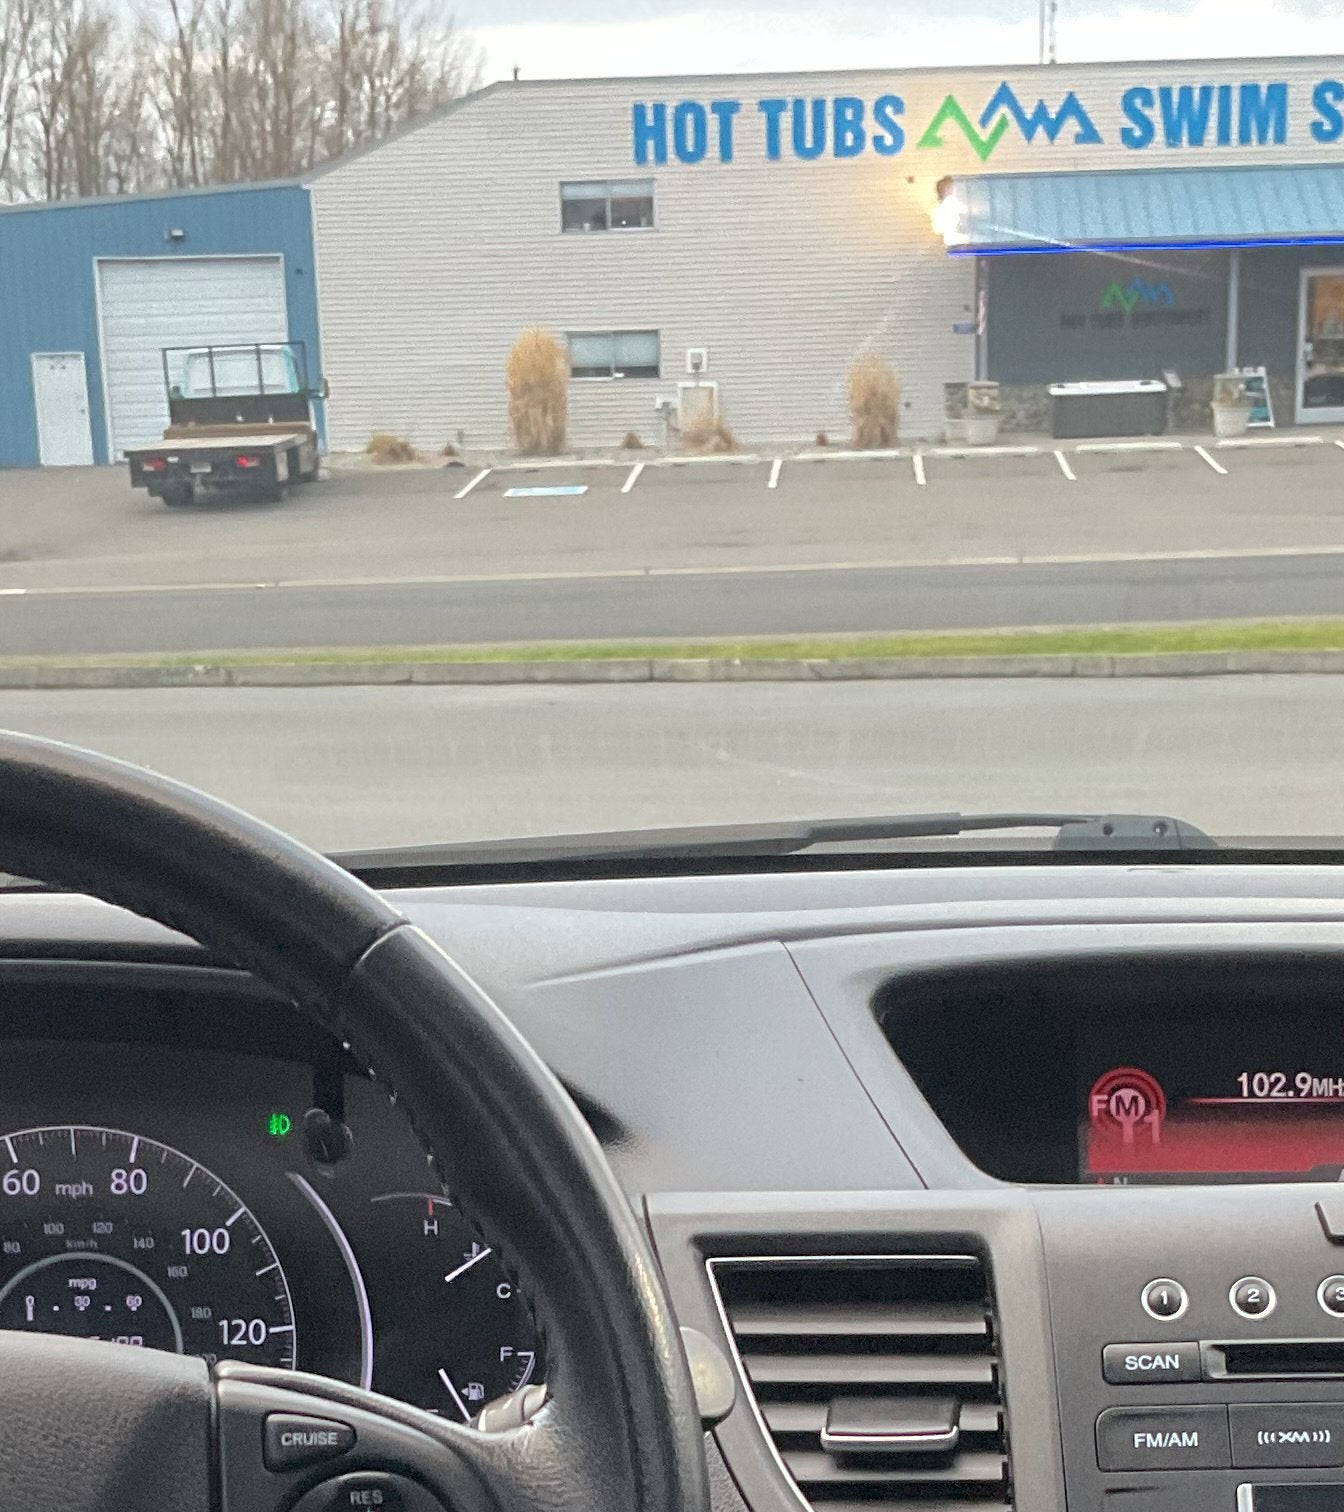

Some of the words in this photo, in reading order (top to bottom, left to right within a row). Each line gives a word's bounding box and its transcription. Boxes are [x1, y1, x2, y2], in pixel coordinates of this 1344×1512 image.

[633, 100, 741, 165] HOT
[758, 95, 906, 161] TUBS
[1120, 83, 1289, 149] SWIM
[2, 1168, 41, 1196] 60
[55, 1179, 94, 1199] mph
[110, 1168, 148, 1196] 80
[43, 1222, 66, 1236] 100
[91, 1221, 114, 1235] 120
[423, 1219, 438, 1236] H
[3, 1240, 21, 1254] 80
[132, 1235, 156, 1250] 140
[180, 1227, 231, 1255] 100
[167, 1265, 189, 1278] 160
[67, 1277, 98, 1291] mpg
[495, 1282, 512, 1299] C
[73, 1295, 91, 1308] 30
[125, 1295, 143, 1308] 60
[1159, 1290, 1169, 1305] 1
[1247, 1287, 1261, 1303] 2
[190, 1306, 212, 1320] 180
[217, 1318, 267, 1346] 120
[499, 1346, 514, 1362] F
[1124, 1354, 1180, 1371] SCAN
[281, 1431, 339, 1447] CRUISE
[1133, 1431, 1199, 1448] FM/AM
[350, 1489, 384, 1505] RES
